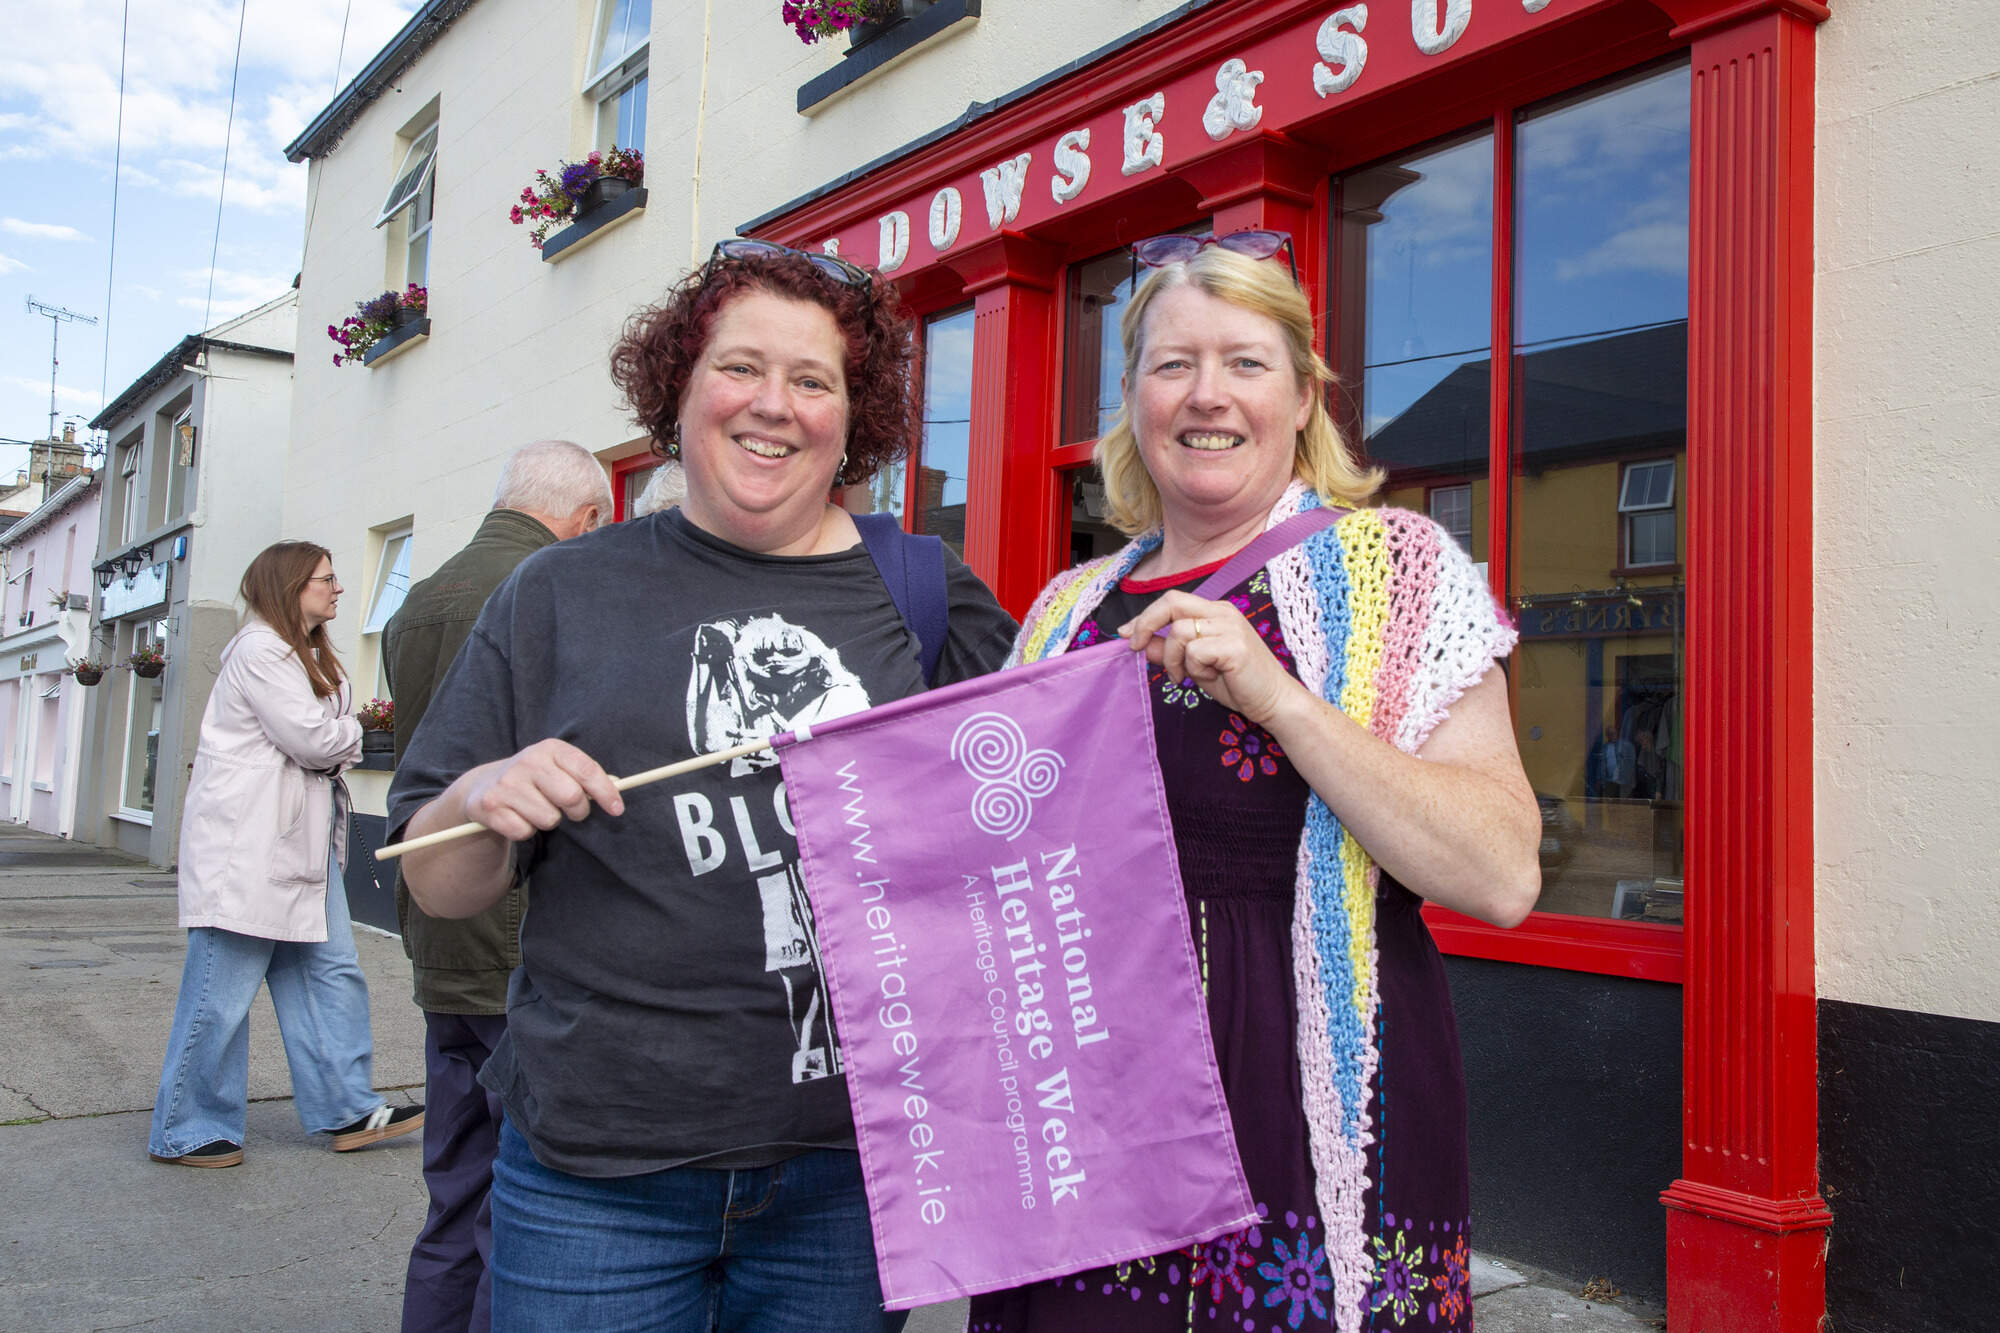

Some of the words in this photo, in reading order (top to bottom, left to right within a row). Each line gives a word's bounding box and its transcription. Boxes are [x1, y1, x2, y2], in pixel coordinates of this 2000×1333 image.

[877, 91, 1165, 273] DOWSE
[1202, 58, 1263, 141] &
[1313, 0, 1551, 99] SO
[961, 873, 980, 890] A
[966, 890, 999, 984] Heritage
[1039, 842, 1110, 1051] National
[835, 759, 951, 1226] www.heritageweek.ie
[987, 986, 1018, 1072] Council
[991, 857, 1054, 1061] Heritage
[1035, 1065, 1086, 1206] Week
[999, 1073, 1036, 1210] programme
